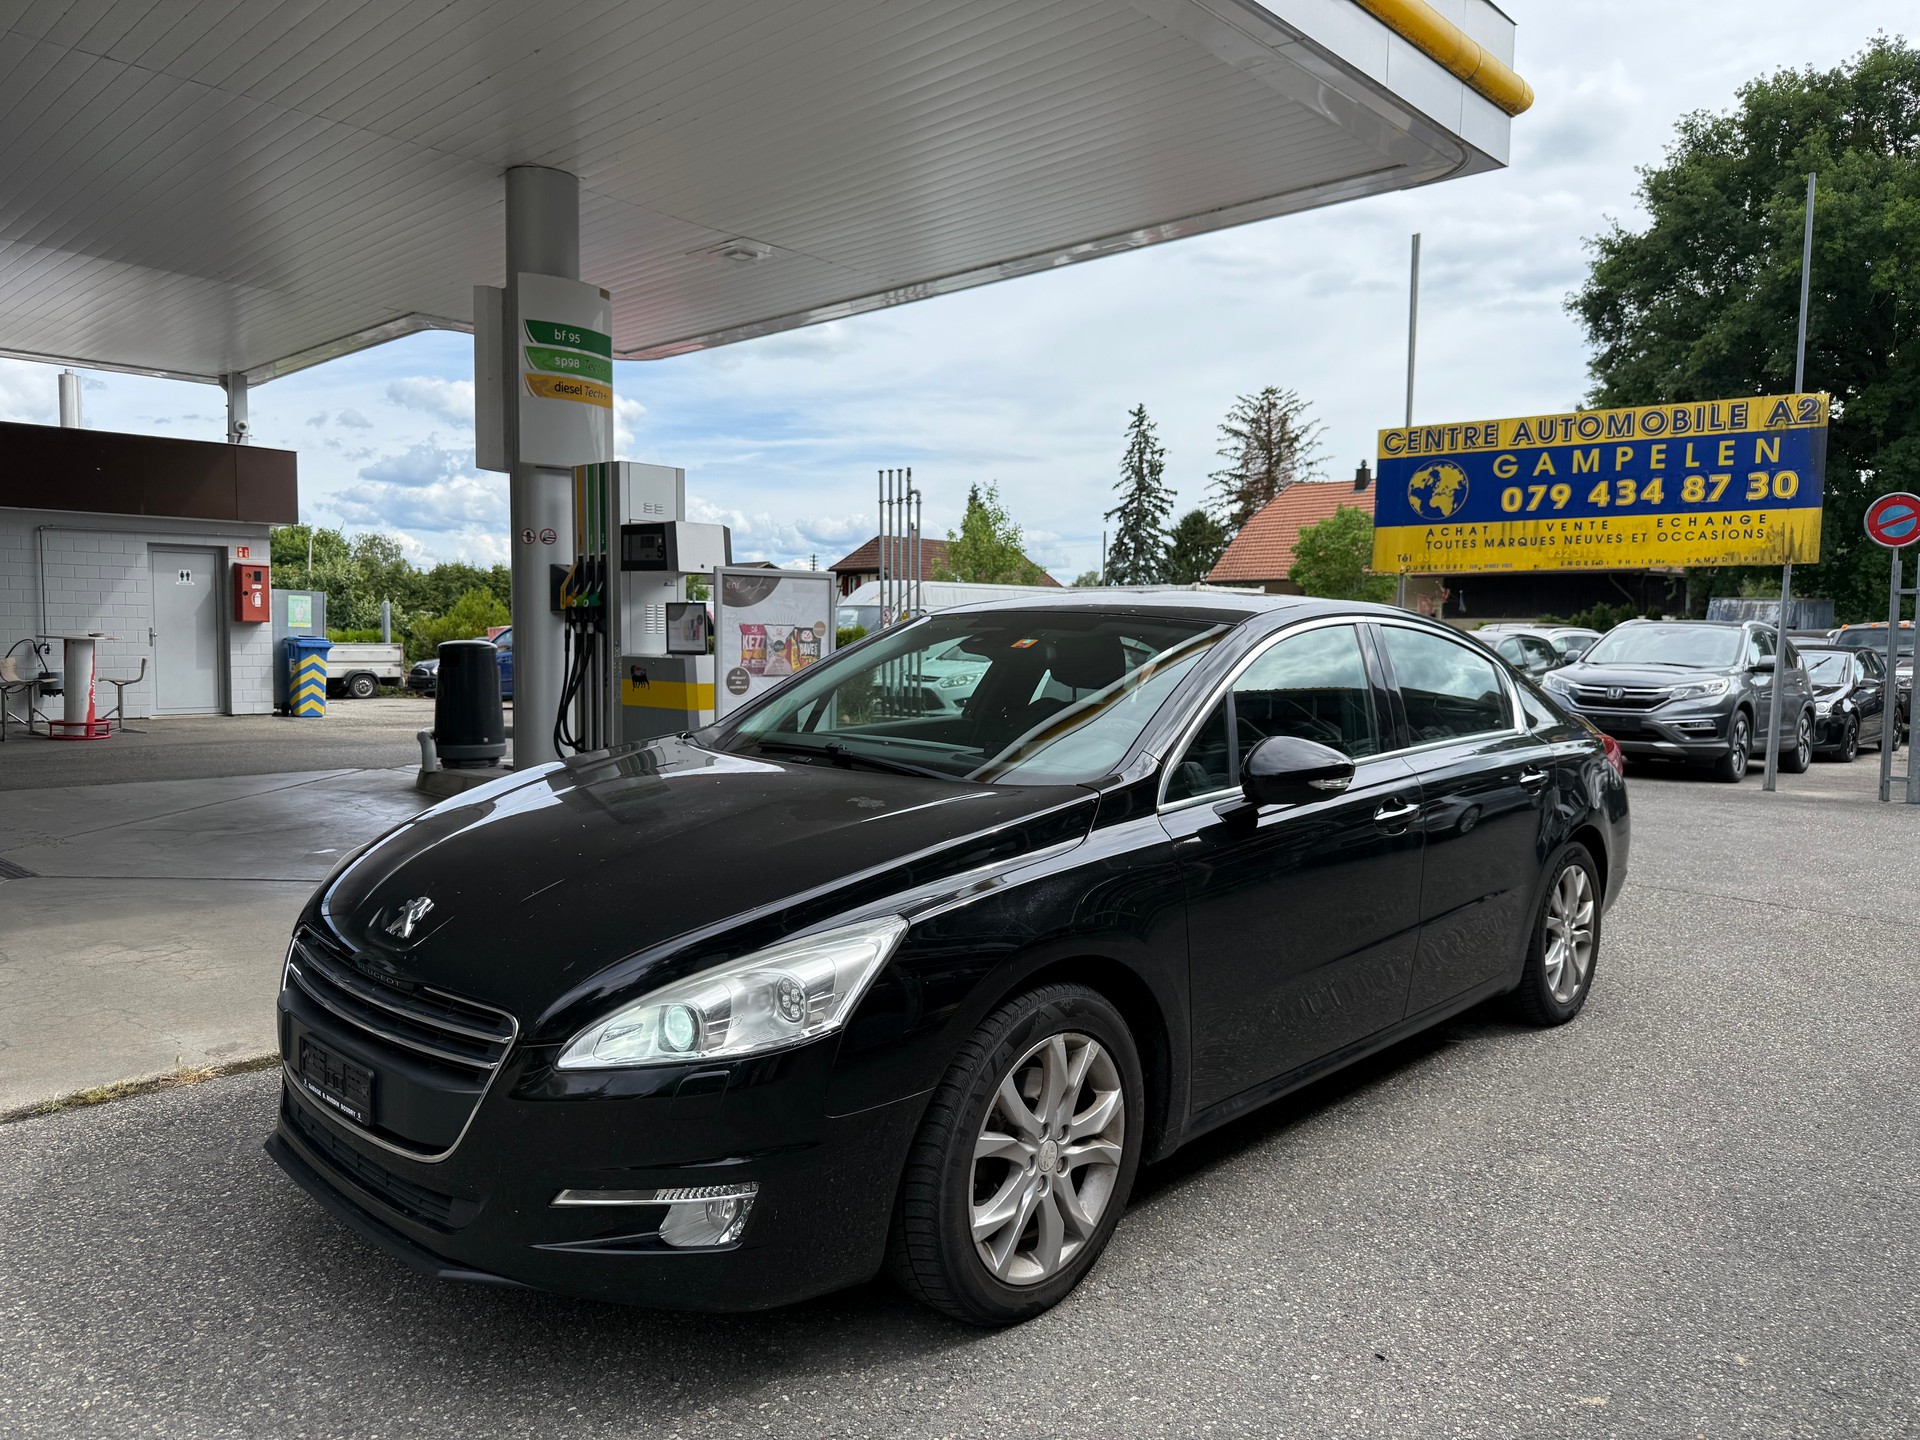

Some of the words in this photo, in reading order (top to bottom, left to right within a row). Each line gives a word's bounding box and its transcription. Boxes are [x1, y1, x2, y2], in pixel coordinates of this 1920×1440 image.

[554, 329, 567, 341] bf
[569, 333, 581, 343] 95
[554, 356, 580, 369] sp98
[554, 381, 582, 395] diesel
[1382, 421, 1499, 454] CENTRE
[1509, 401, 1749, 446] AUTOMOBILE
[1764, 396, 1821, 427] A2
[1492, 436, 1781, 478] GAMPELEN
[1500, 482, 1572, 513] 079
[1587, 477, 1665, 508] 434
[1680, 473, 1732, 504] 87
[1745, 470, 1799, 501] 30
[1425, 525, 1489, 539] ACHAT
[1546, 520, 1609, 532] VENTE
[1656, 513, 1767, 528] ECHANGE
[1425, 538, 1477, 550] TOUTES
[1484, 536, 1556, 548] MARQUES
[1563, 533, 1623, 545] NEUVES
[1631, 532, 1648, 543] ET
[1656, 528, 1765, 543] OCCASIONS
[656, 545, 664, 559] 5
